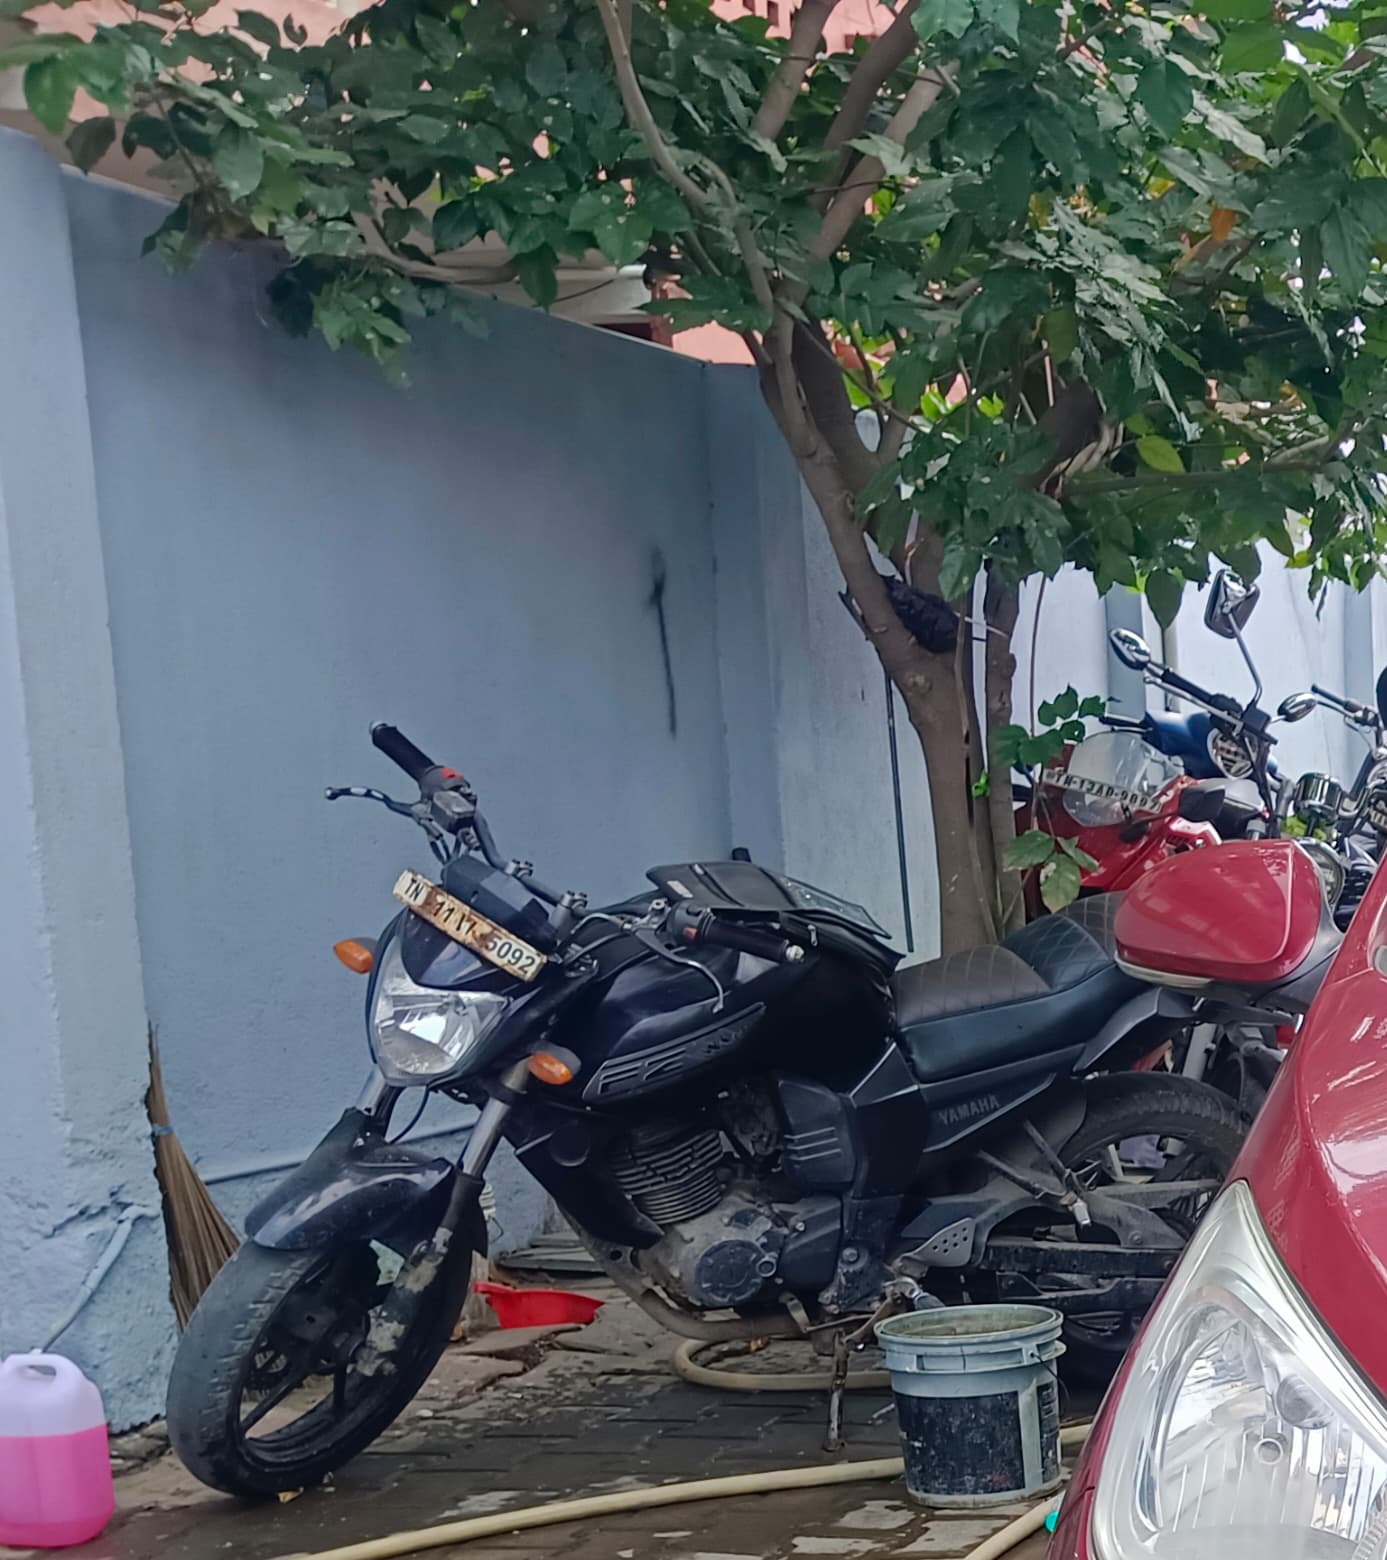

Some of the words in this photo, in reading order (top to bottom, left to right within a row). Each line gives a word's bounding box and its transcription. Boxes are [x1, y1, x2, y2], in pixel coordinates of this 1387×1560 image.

[404, 877, 424, 901] TN
[485, 936, 536, 974] 5092
[938, 1093, 1000, 1126] YAMAHA
